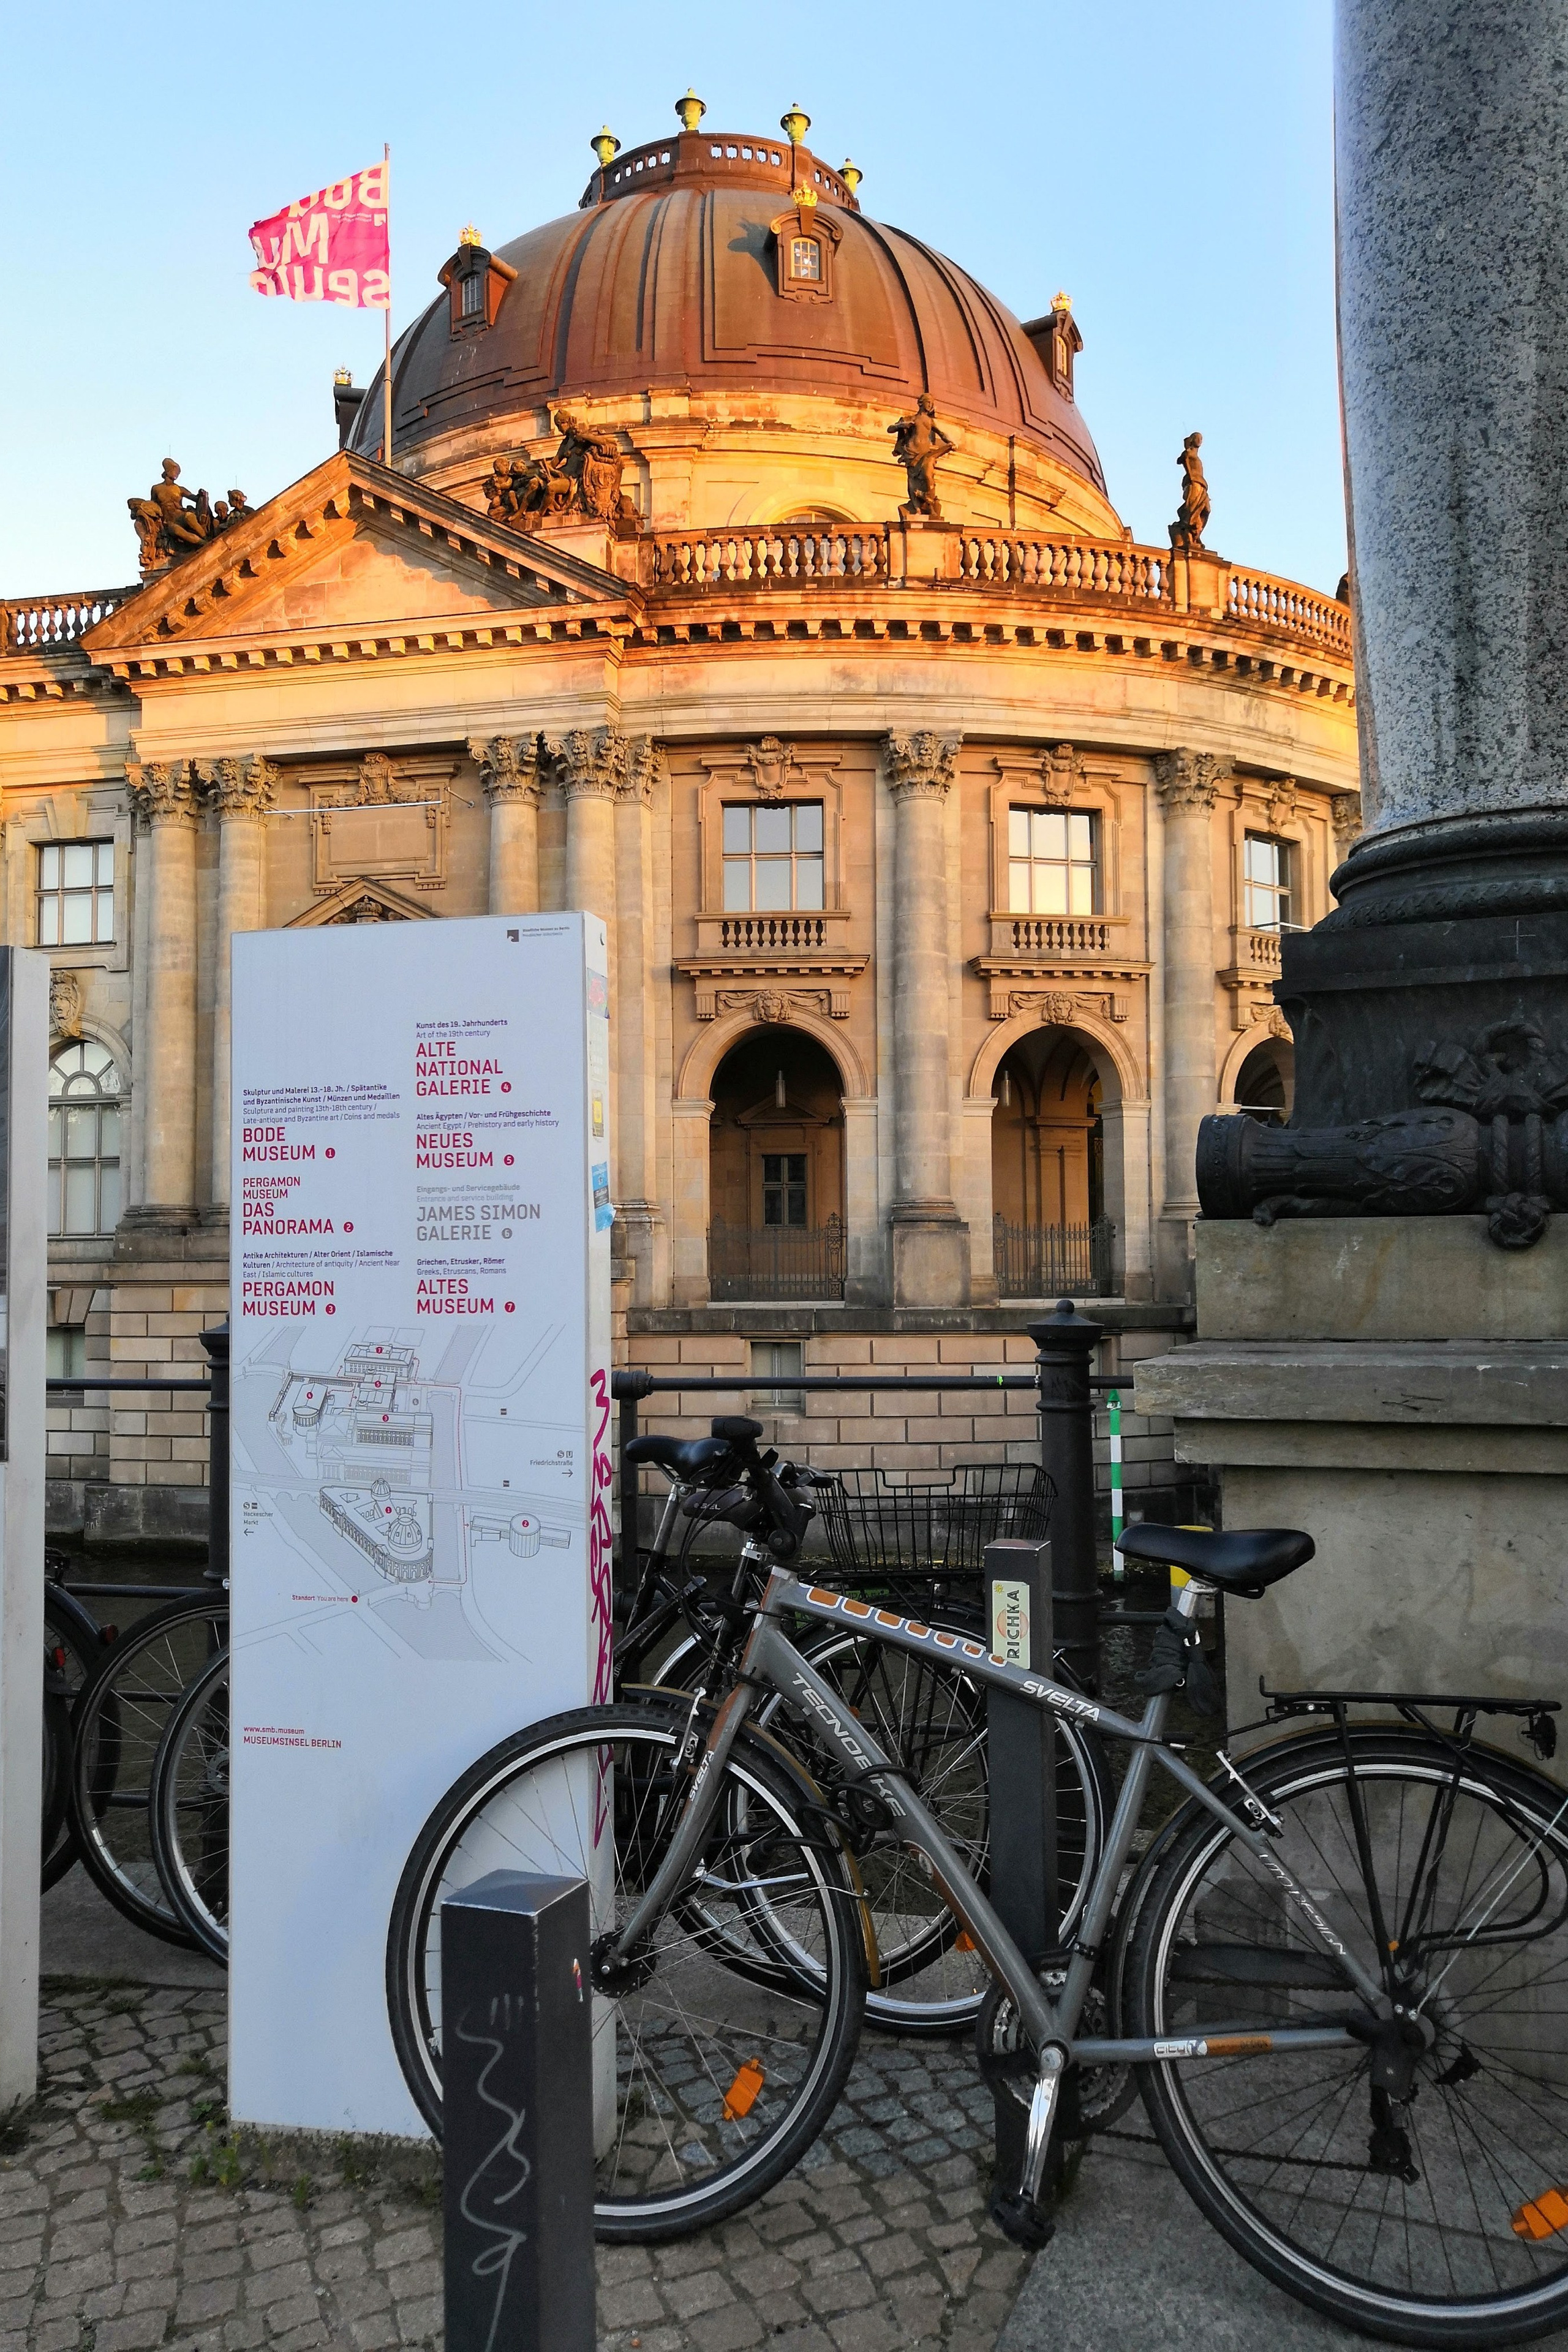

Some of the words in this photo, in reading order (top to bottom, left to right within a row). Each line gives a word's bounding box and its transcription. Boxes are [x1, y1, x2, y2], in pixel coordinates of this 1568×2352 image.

[416, 1042, 456, 1058] ALTE
[416, 1060, 503, 1077] NATIONAL
[416, 1079, 491, 1096] GALERIE
[256, 1097, 301, 1106] Byzantinische
[297, 1114, 328, 1123] Byzantine
[435, 1112, 462, 1121] Ägypten
[499, 1109, 551, 1118] Frühgeschichte
[243, 1126, 285, 1143] BODE
[416, 1133, 473, 1149] NEUES
[243, 1145, 315, 1161] MUSEUM
[416, 1152, 493, 1169] MUSEUM
[243, 1177, 301, 1188] PERGAMON
[243, 1189, 288, 1199] MUSEUM
[243, 1202, 274, 1218] DAS
[416, 1205, 475, 1222] JAMES
[480, 1204, 541, 1220] SIMON
[243, 1219, 334, 1236] PANORAMA
[416, 1224, 491, 1242] GALERIE
[325, 1260, 353, 1268] antiquity
[243, 1280, 334, 1297] PERGAMON
[417, 1279, 469, 1295] ALTES
[243, 1300, 315, 1316] MUSEUM
[417, 1298, 494, 1314] MUSEUM
[1007, 1589, 1020, 1659] RICHKA
[1019, 1680, 1100, 1722] SVELTA
[244, 1726, 304, 1735] www.smb.museum
[243, 1736, 309, 1747] MUSEUMSINSEL
[311, 1739, 342, 1748] BERLIN
[689, 1750, 715, 1801] SVELTA
